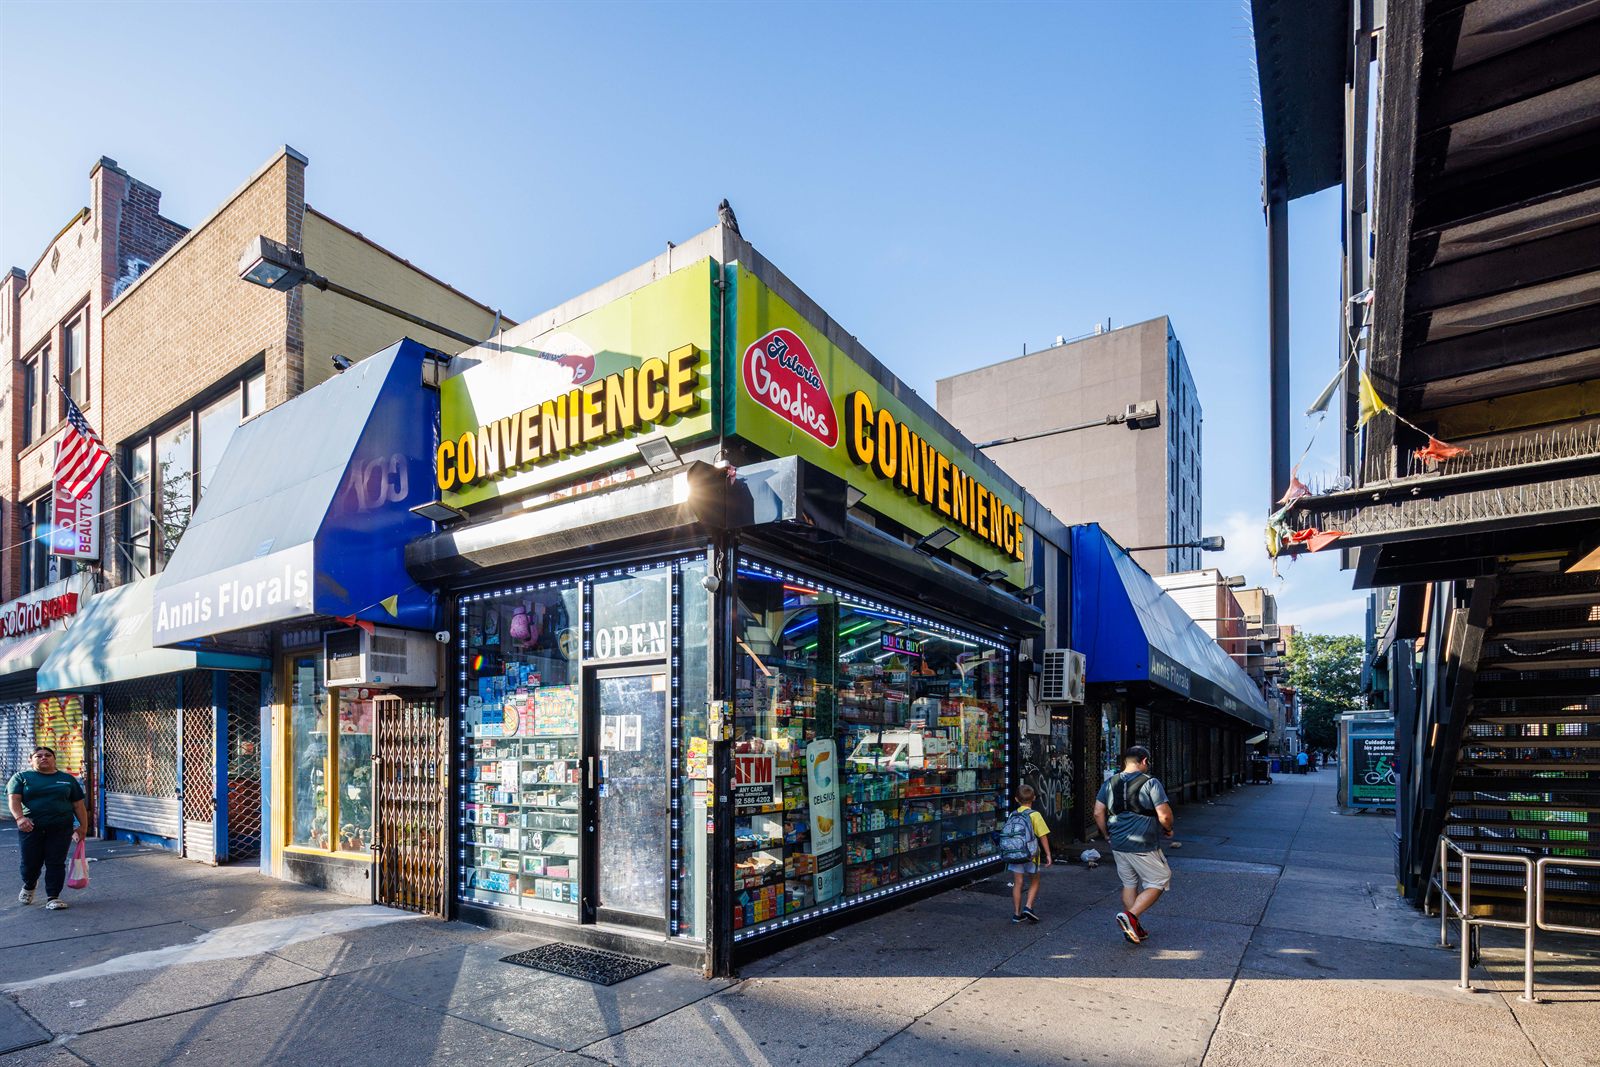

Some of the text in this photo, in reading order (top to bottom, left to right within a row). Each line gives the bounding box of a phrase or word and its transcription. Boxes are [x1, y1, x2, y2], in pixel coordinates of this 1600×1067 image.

[767, 335, 820, 391] Astoria
[437, 343, 698, 491] CONVENIENCE
[751, 348, 829, 436] Goodies
[847, 389, 1024, 562] CONVENIENCE
[79, 503, 93, 553] BEAUTY
[156, 591, 212, 633] Annis
[218, 564, 309, 617] Florals
[595, 620, 667, 659] OPEN
[906, 639, 920, 653] BUY
[1151, 654, 1189, 690] Annis Florals
[736, 757, 772, 784] ATM
[814, 792, 835, 805] CELSIUS
